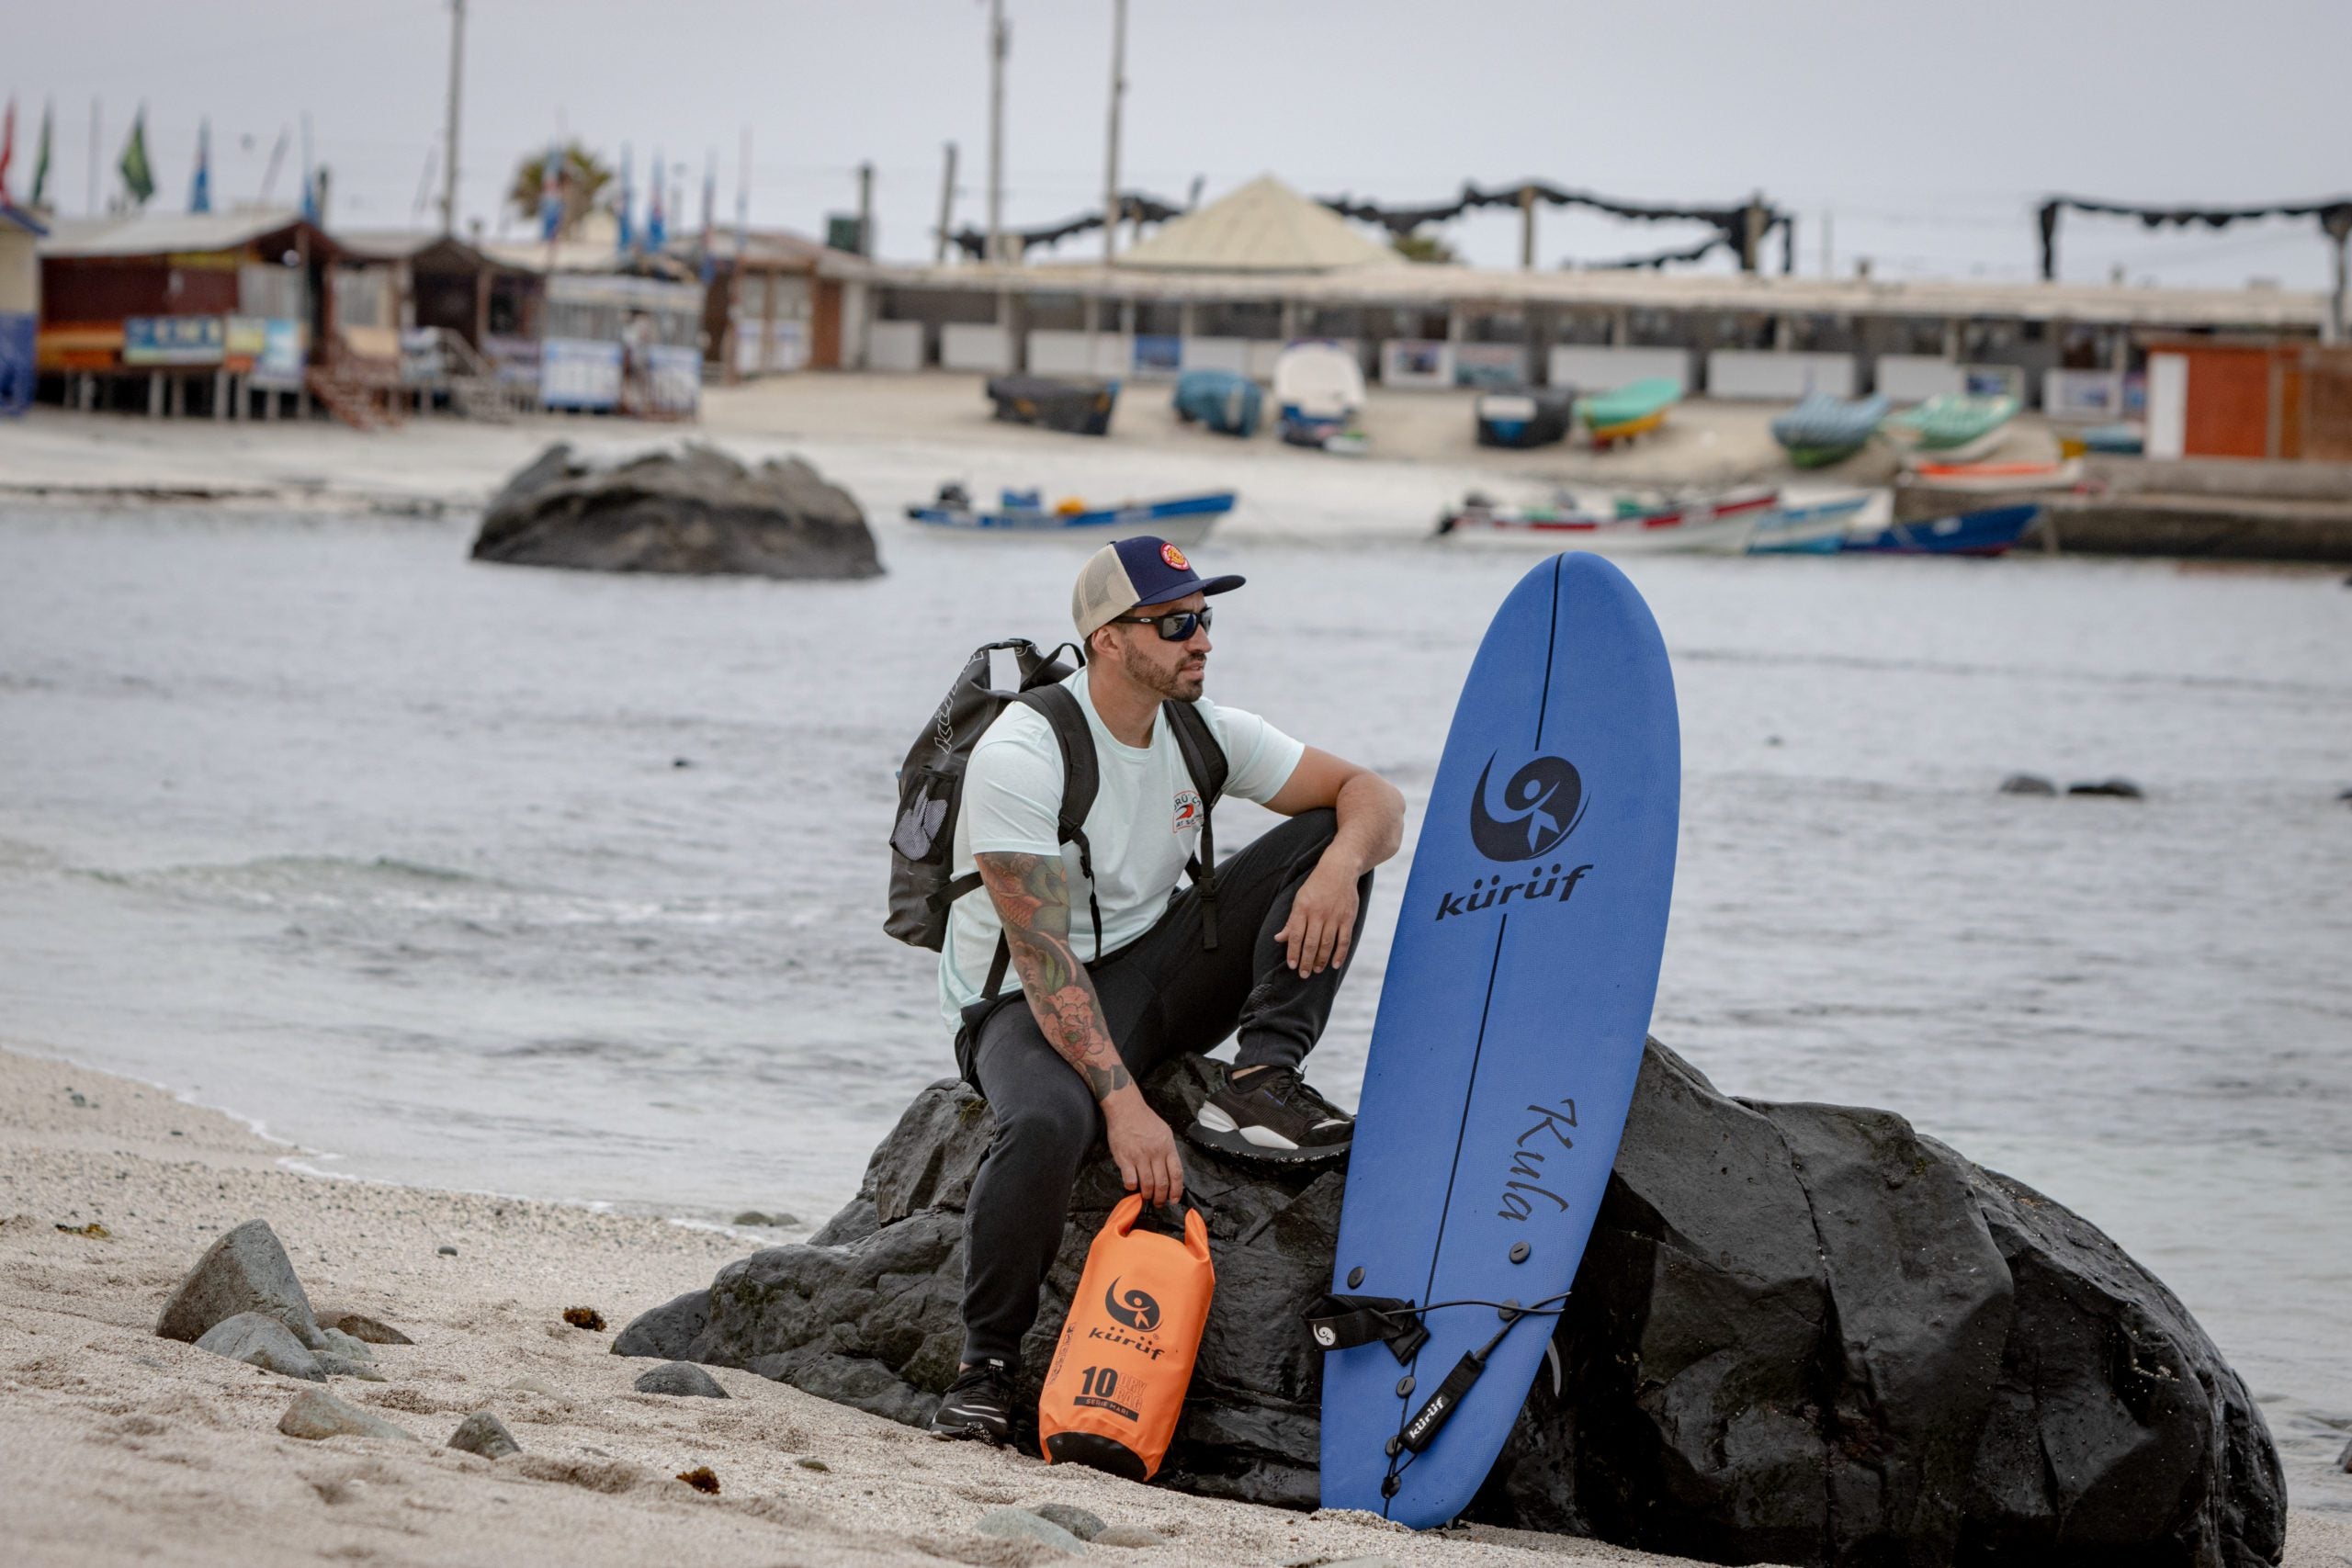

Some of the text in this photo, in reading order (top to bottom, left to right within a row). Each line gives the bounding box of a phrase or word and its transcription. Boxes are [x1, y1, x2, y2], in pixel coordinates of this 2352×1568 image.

[1435, 863, 1594, 921] kürüf
[1498, 1099, 1577, 1222] Kula
[1089, 1326, 1165, 1360] kürüf
[1081, 1366, 1118, 1398] 10
[1114, 1386, 1143, 1411] BAG
[1117, 1372, 1148, 1394] DRY
[1085, 1398, 1129, 1416] SERIE MARI
[1408, 1396, 1443, 1439] kürüf
